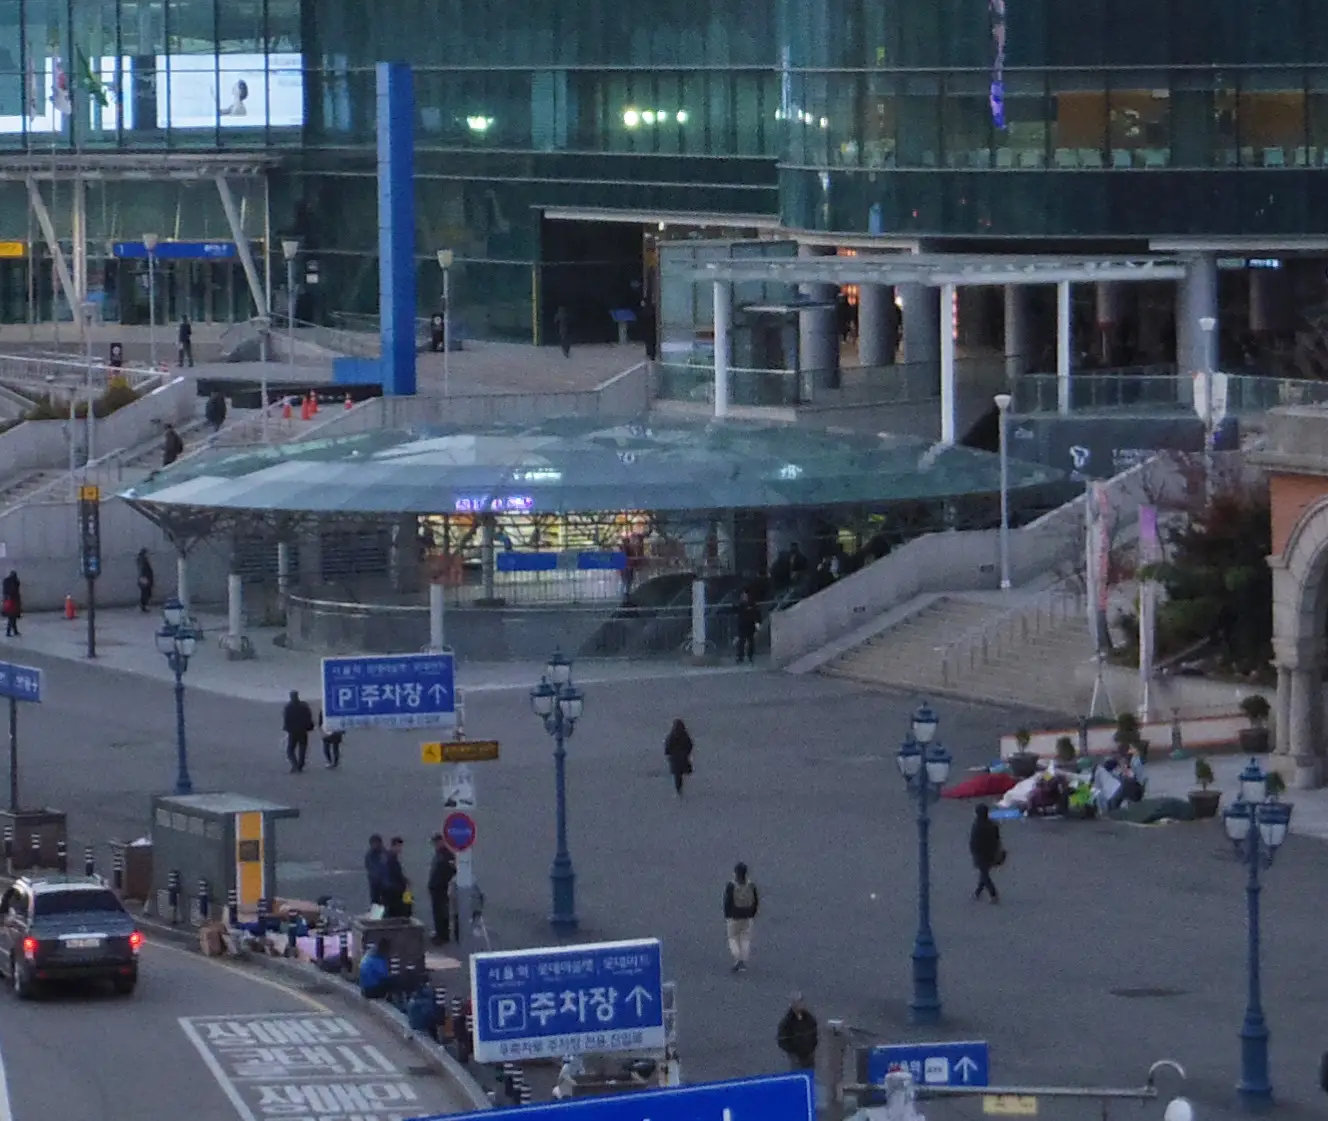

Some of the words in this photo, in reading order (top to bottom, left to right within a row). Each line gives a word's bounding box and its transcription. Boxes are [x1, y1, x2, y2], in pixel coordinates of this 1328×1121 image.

[338, 688, 352, 709] P
[361, 682, 423, 708] 주차장
[497, 999, 516, 1027] P
[530, 986, 618, 1027] 주차장
